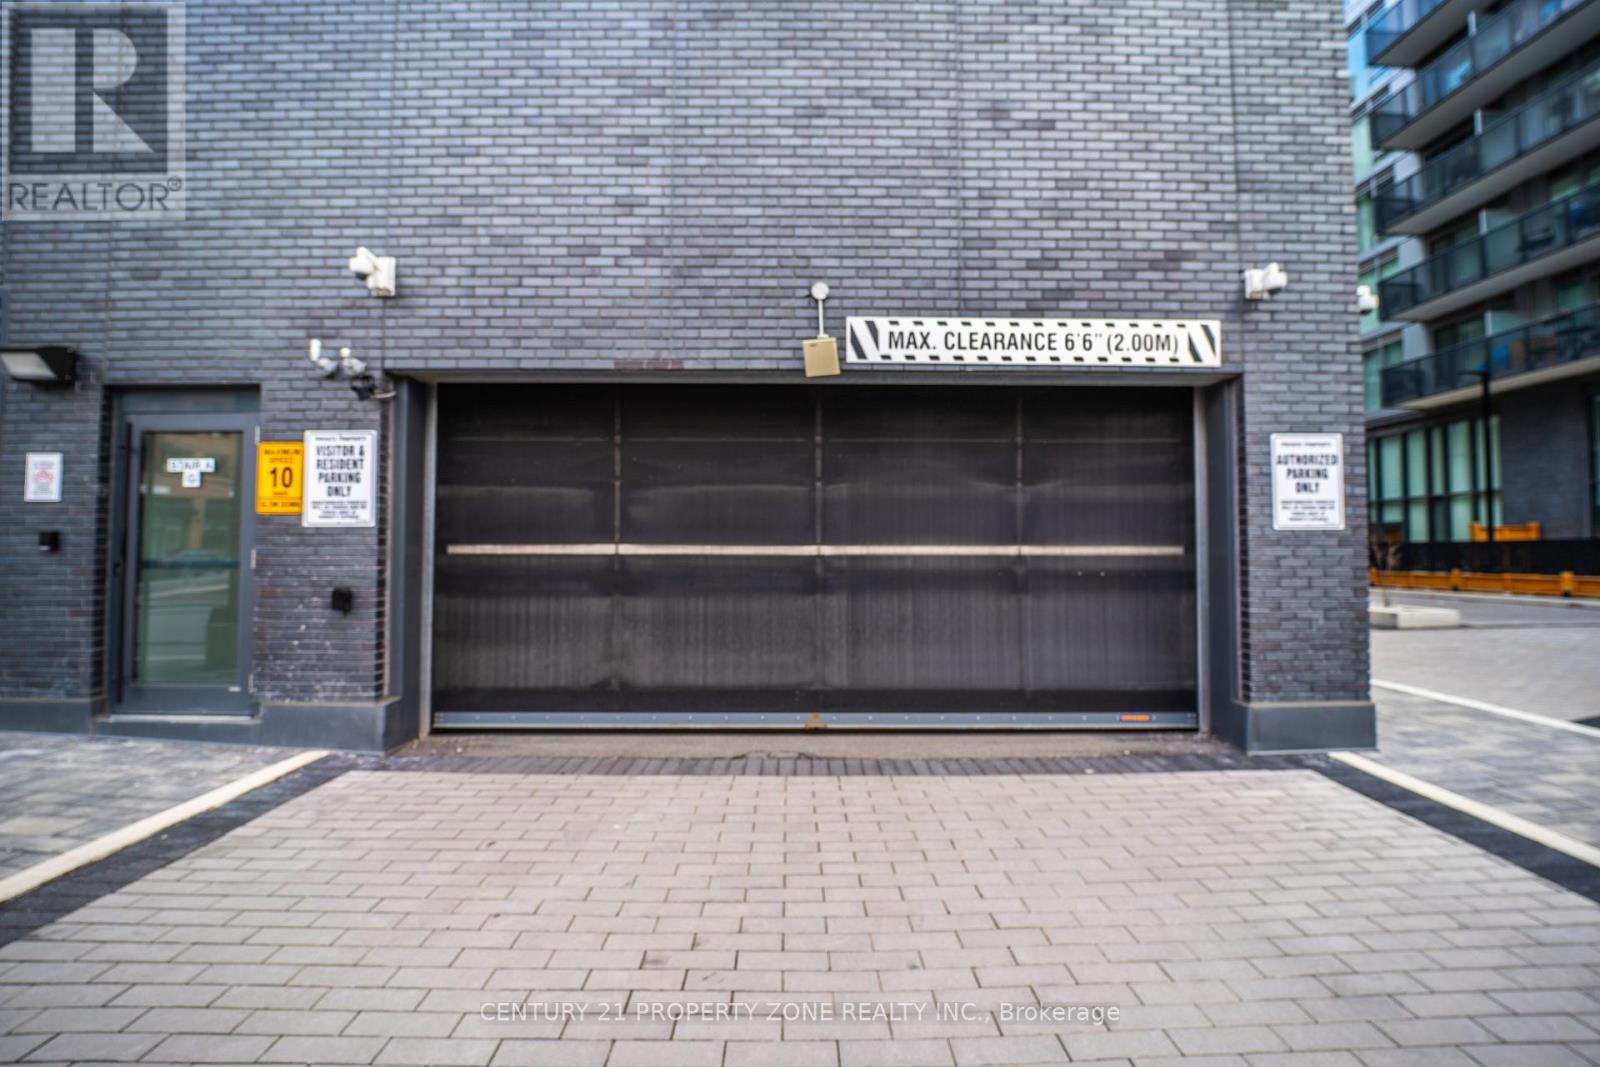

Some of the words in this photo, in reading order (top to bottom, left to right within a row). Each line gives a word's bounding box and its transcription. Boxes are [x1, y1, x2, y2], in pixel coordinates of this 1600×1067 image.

[888, 331, 936, 350] MAX.
[944, 331, 1057, 351] CLEARANCE
[316, 445, 356, 457] VISITOR
[358, 445, 366, 457] &
[316, 459, 365, 470] RESIDENT
[1276, 454, 1339, 466] AUTHORIZED
[269, 466, 294, 489] 10
[318, 472, 362, 484] PARKING
[1286, 468, 1329, 480] PARKING
[326, 485, 353, 497] ONLY
[1295, 482, 1320, 494] ONLY
